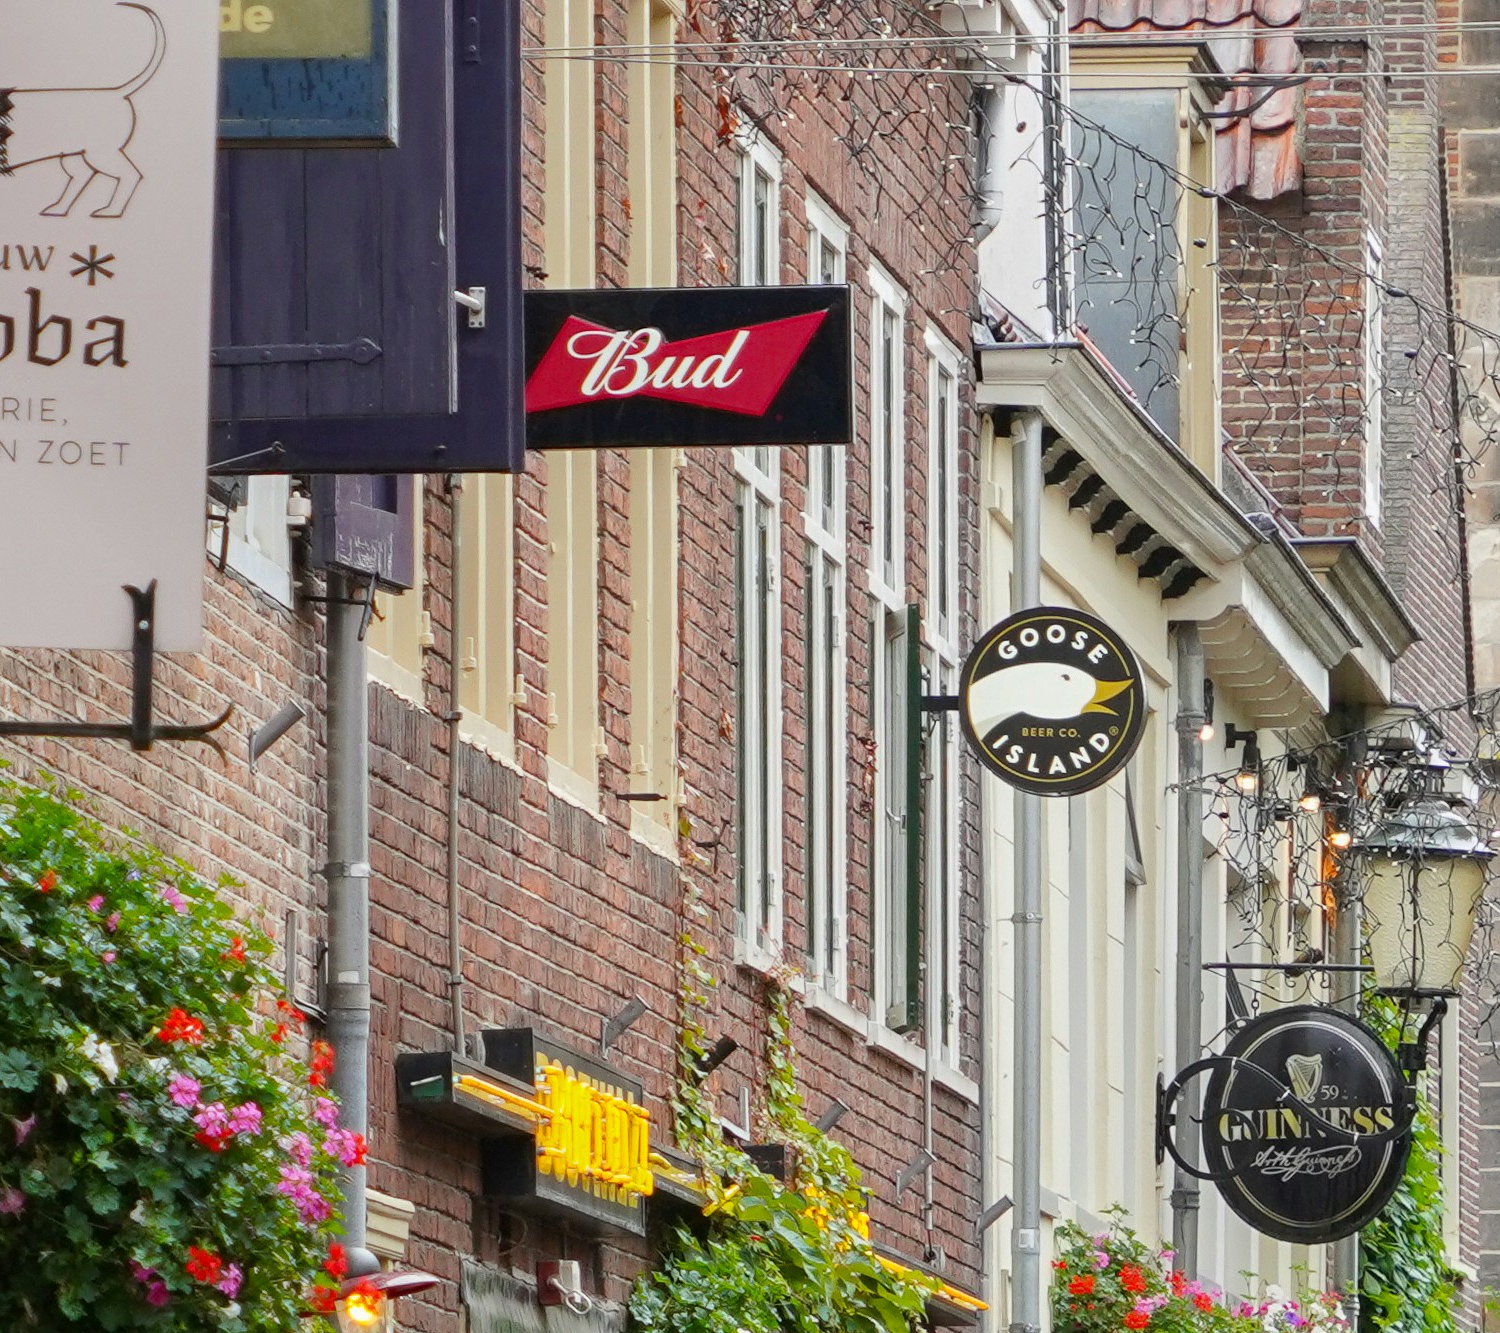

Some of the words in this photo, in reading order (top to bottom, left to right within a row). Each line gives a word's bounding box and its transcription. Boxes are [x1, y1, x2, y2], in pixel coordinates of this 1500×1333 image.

[566, 327, 750, 396] Bud
[37, 439, 132, 466] ZOET
[997, 624, 1109, 665] GOOSE
[1021, 727, 1054, 738] BEER
[1058, 727, 1082, 738] CO.
[992, 732, 1110, 775] ISLAND
[1219, 1105, 1395, 1143] GUINNESS
